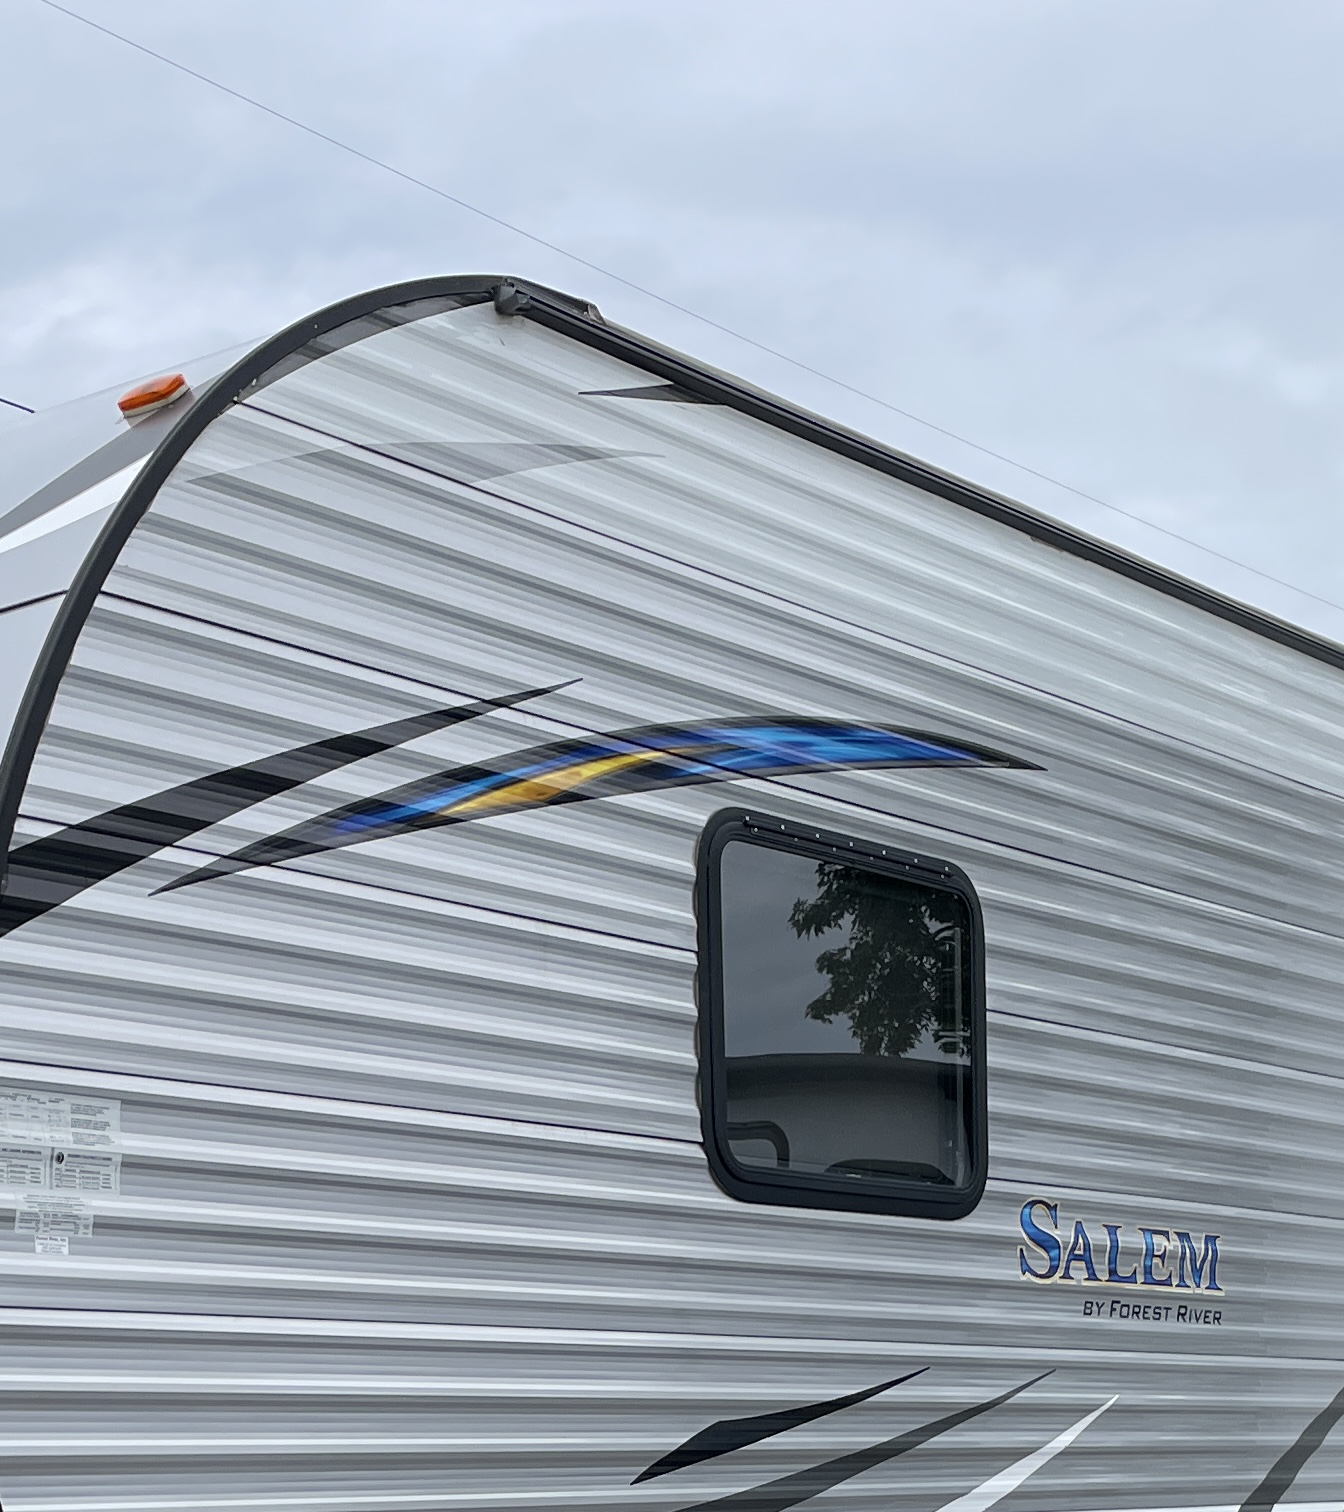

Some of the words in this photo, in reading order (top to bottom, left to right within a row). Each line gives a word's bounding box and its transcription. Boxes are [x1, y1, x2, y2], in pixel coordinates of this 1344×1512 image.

[1018, 1197, 1225, 1296] SALEM
[1083, 1300, 1105, 1317] BY
[1109, 1300, 1172, 1322] FOREST
[1176, 1305, 1222, 1326] RIVER
